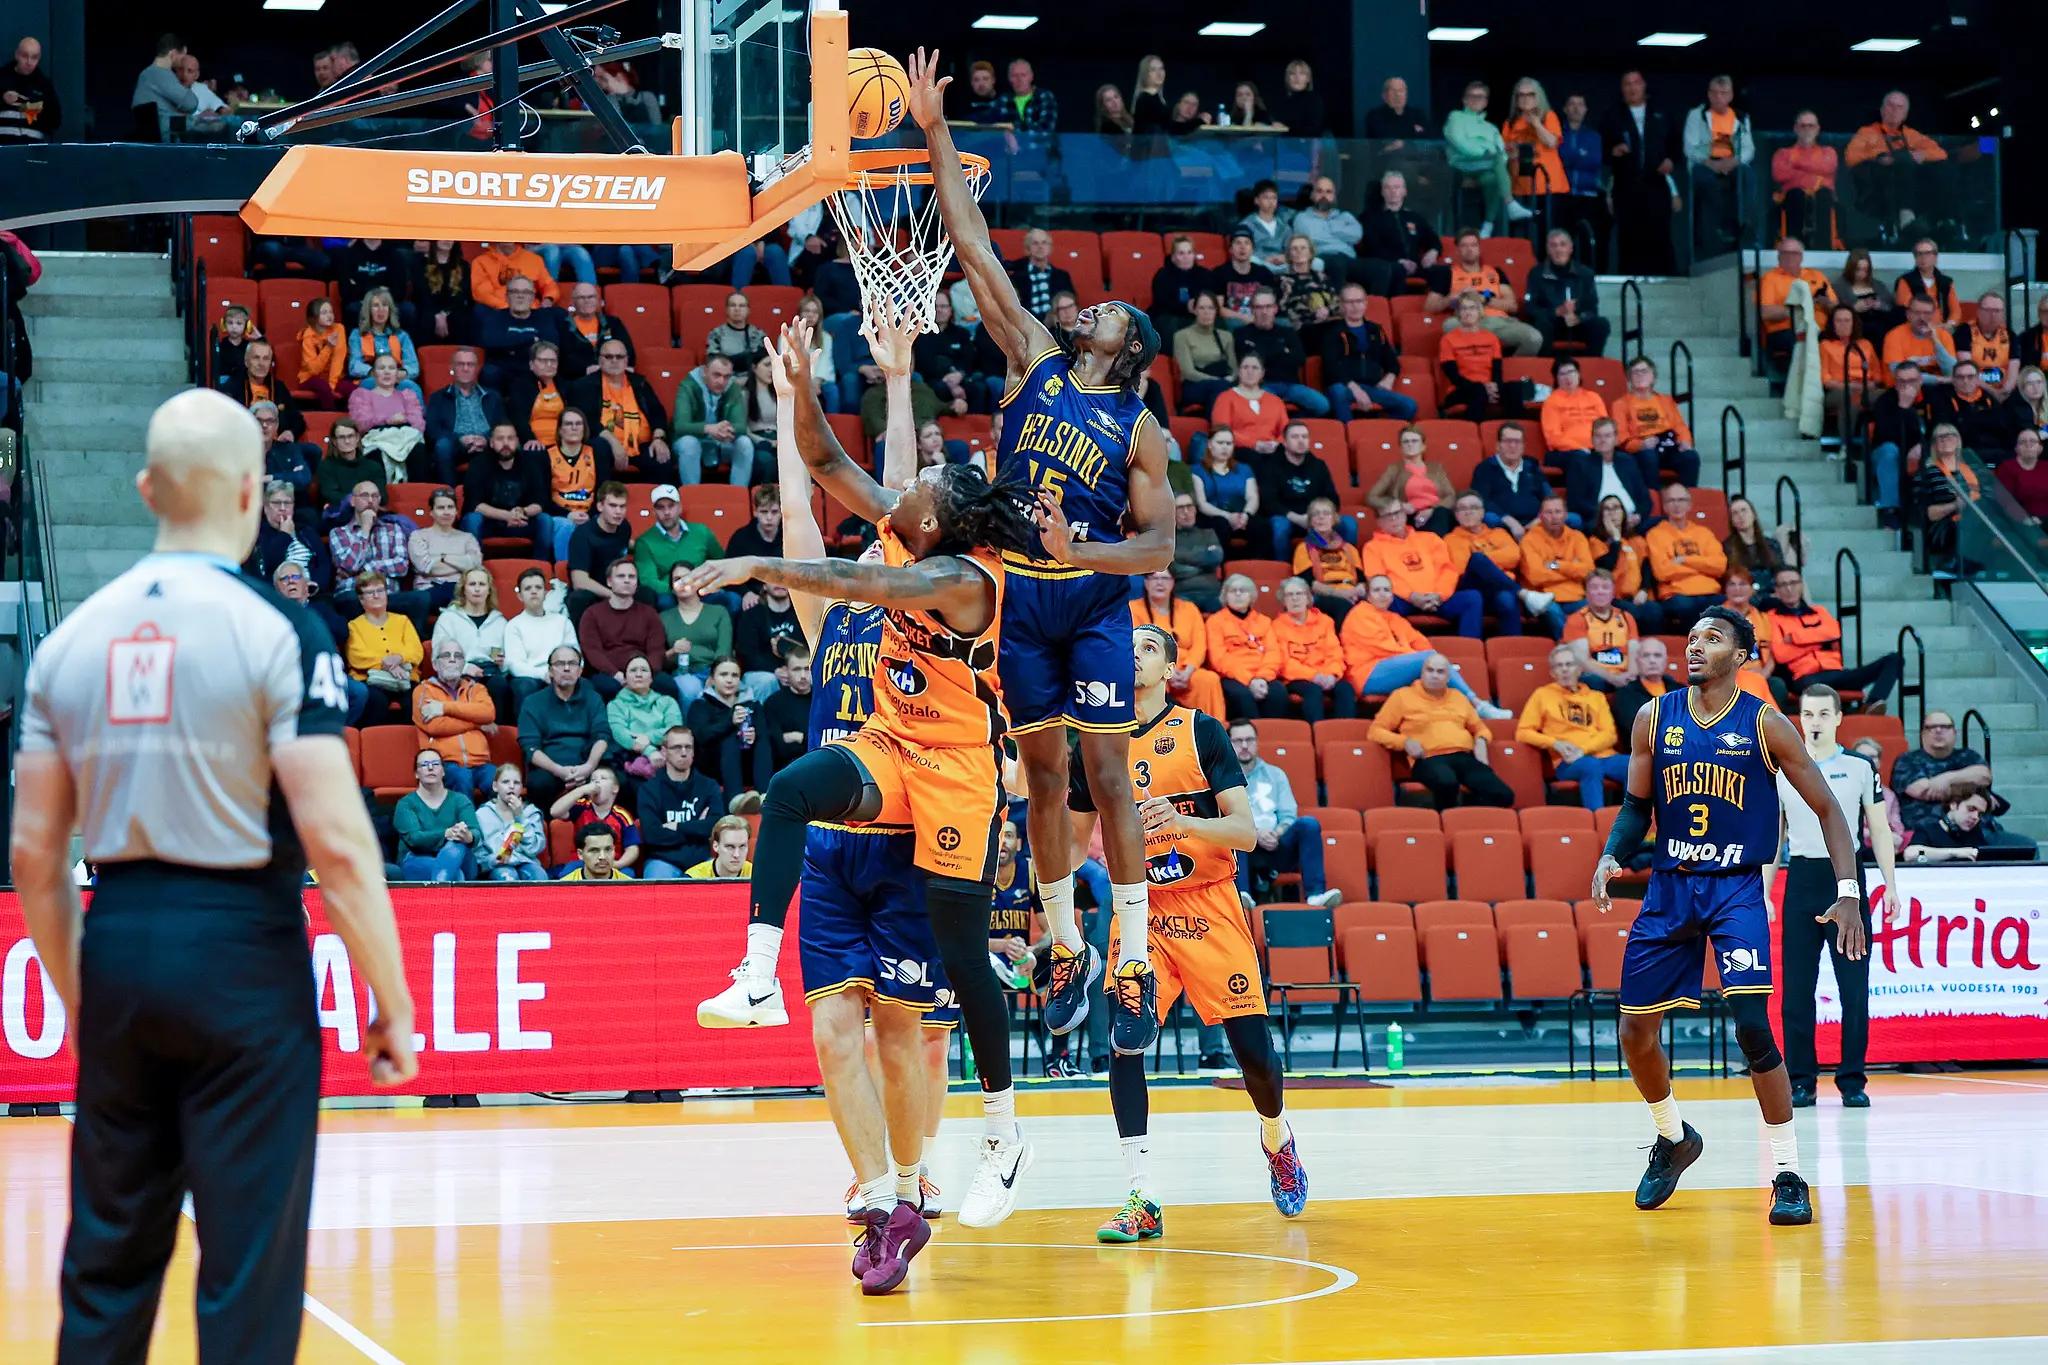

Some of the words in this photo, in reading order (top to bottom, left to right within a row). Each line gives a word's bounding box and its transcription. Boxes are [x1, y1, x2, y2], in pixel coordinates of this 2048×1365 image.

[407, 168, 523, 197] SPORT
[524, 174, 667, 208] SYSTEM
[1014, 413, 1109, 491] HELSINKI
[836, 683, 868, 722] 11
[1075, 680, 1126, 707] SOL
[1663, 747, 1682, 756] tiketti
[1715, 747, 1751, 757] jakosport.fi
[1134, 761, 1151, 788] 3
[1662, 761, 1746, 811] HELSINKI
[1688, 804, 1709, 837] 3
[1147, 914, 1210, 933] AKEUS
[1869, 884, 2041, 974] Atria
[880, 956, 934, 988] SOL
[1723, 948, 1767, 975] SOL
[934, 987, 961, 1009] OL
[1941, 983, 2006, 994] VUODESTA
[2011, 985, 2039, 996] 1903
